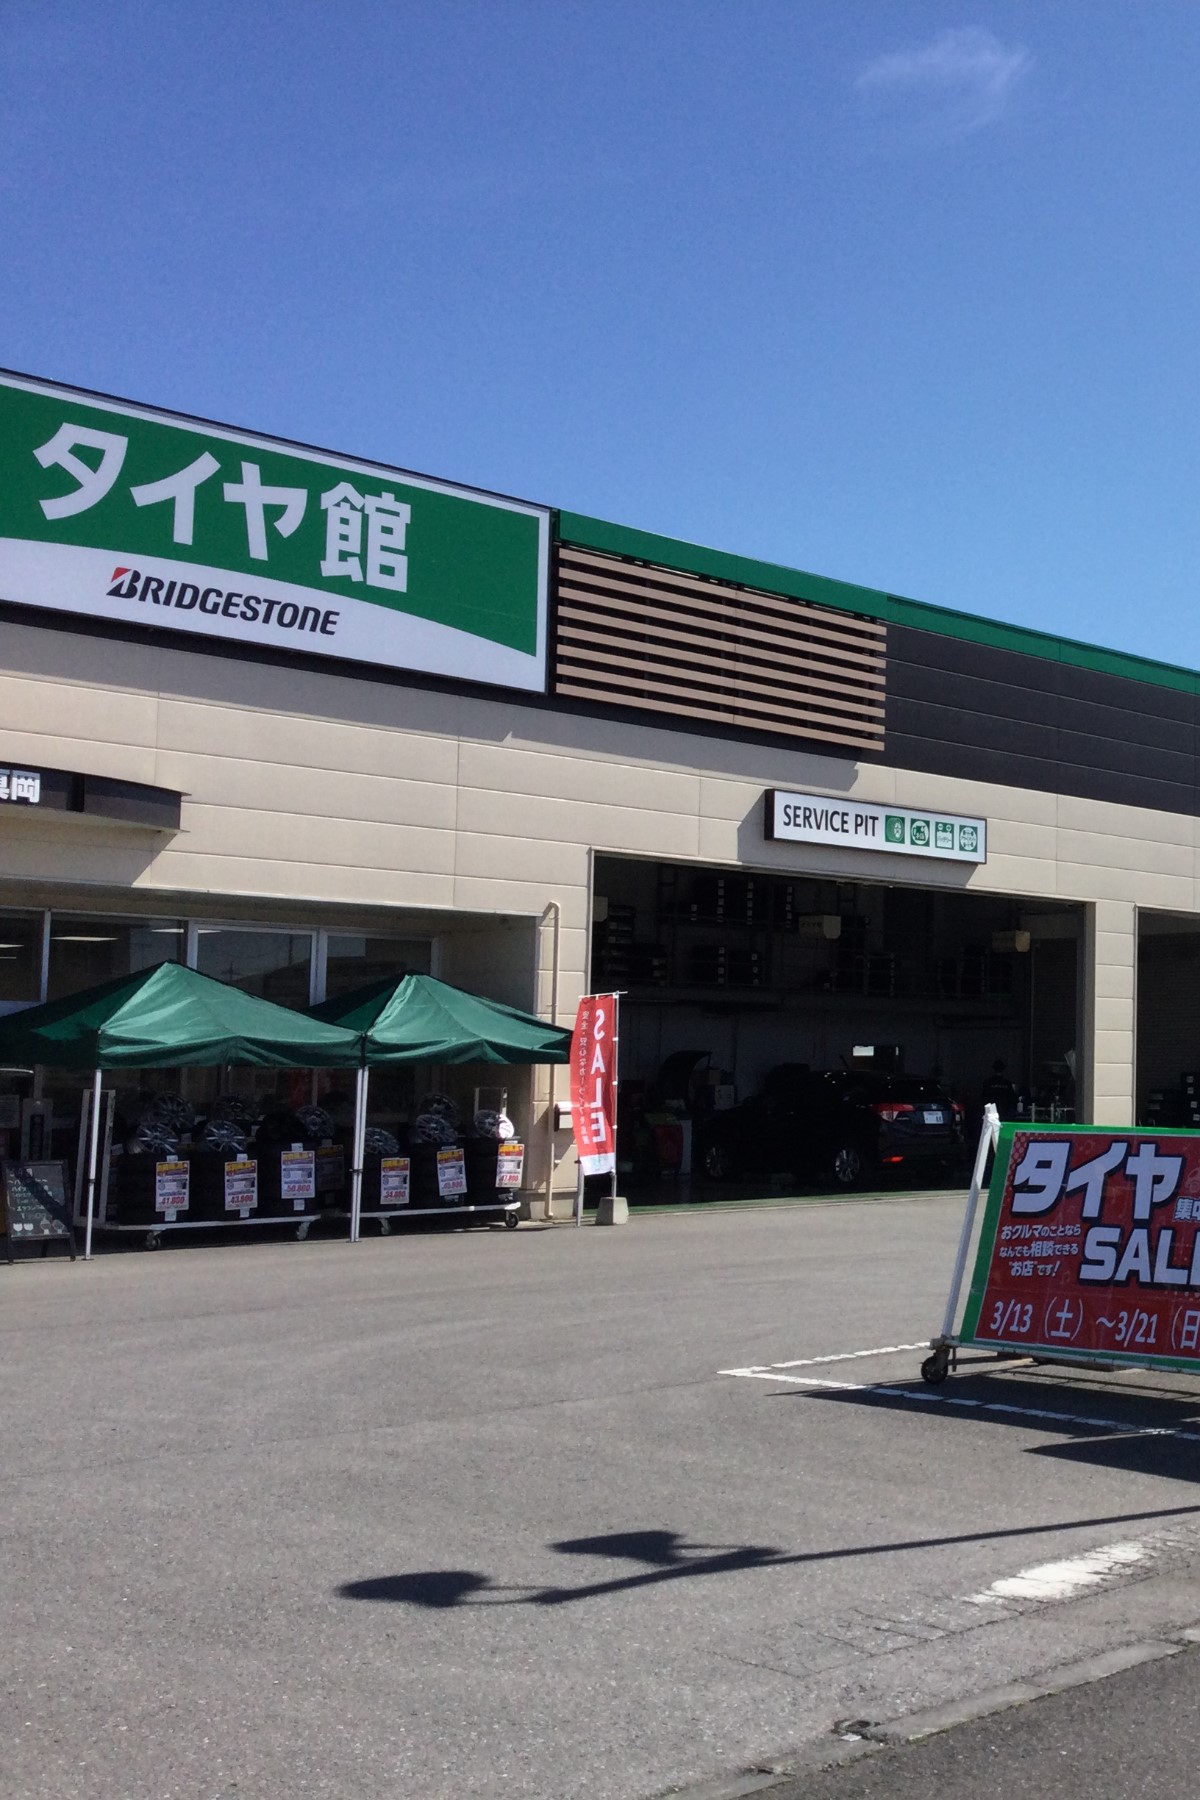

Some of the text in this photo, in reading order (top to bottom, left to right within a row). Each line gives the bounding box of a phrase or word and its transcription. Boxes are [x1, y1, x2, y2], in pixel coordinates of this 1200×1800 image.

[33, 421, 411, 593] タイヤ館
[106, 566, 340, 636] BRIDGESTONE
[783, 804, 879, 837] SERVICE PIT
[1011, 1141, 1184, 1220] タイヤ
[999, 1241, 1079, 1258] なんでも相談できる
[1000, 1223, 1081, 1241] おクルマのことなら
